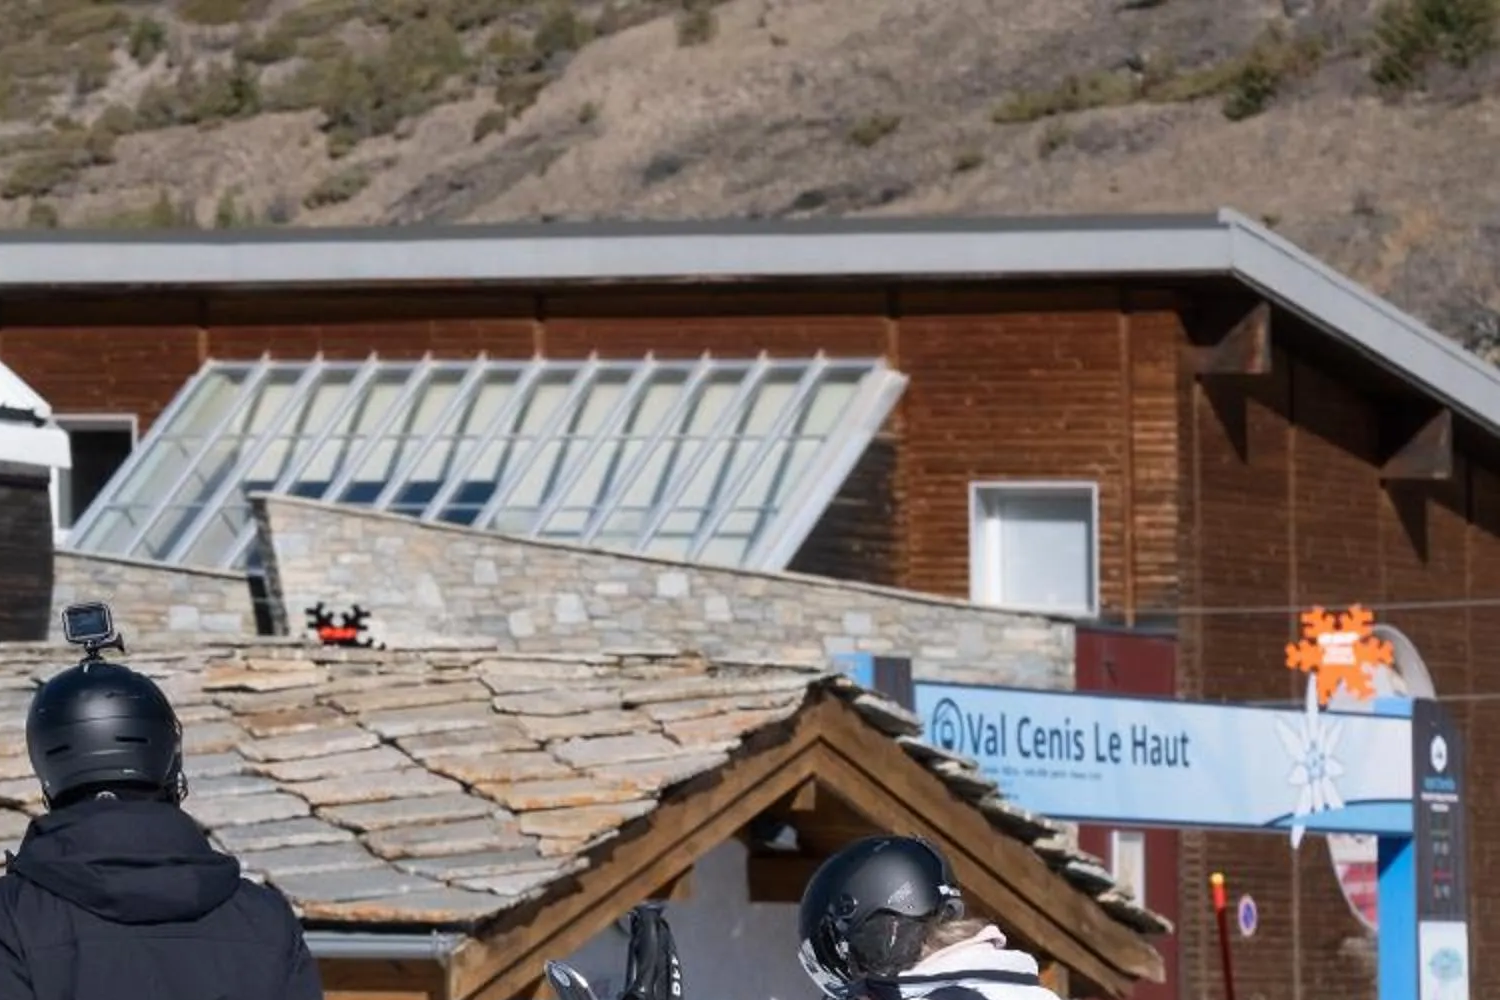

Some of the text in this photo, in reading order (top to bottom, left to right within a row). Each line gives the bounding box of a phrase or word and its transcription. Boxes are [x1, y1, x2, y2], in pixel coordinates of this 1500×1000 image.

[967, 713, 1191, 768] Val Cenis Le Haut
